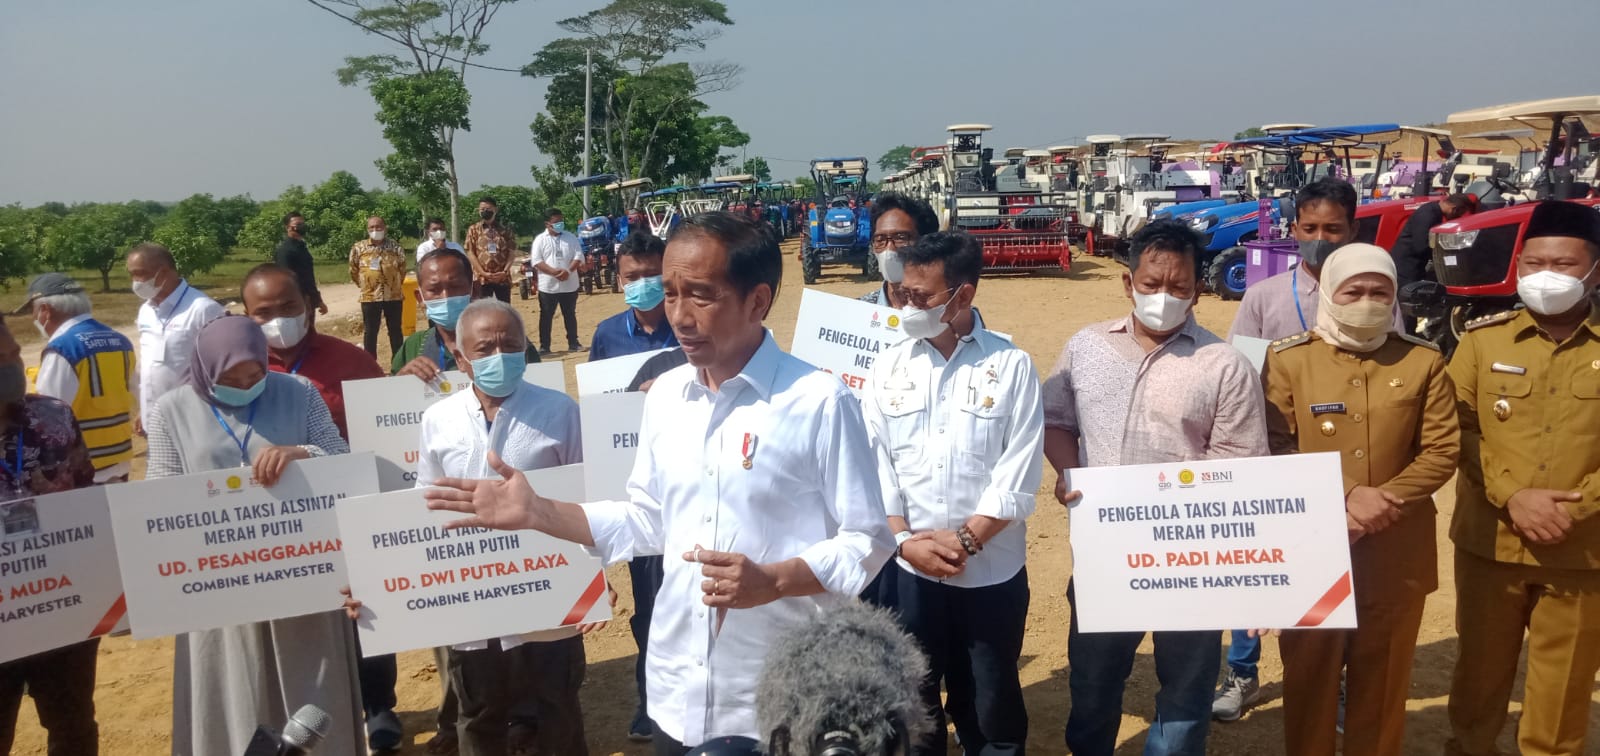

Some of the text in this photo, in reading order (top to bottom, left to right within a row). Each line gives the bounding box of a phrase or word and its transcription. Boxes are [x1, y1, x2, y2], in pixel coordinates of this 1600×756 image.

[818, 327, 880, 354] PENGELOLA
[854, 354, 875, 370] ME
[1212, 470, 1233, 481] BNI
[146, 508, 230, 533] PENGELOLA
[234, 502, 275, 521] TAKSI
[1098, 497, 1306, 523] PENGELOLA TAKSI ALSINTAN
[23, 524, 94, 552] ALSINTAN
[204, 518, 303, 546] MERAH PUTIH
[372, 526, 450, 549] PENGELOLA
[1153, 522, 1256, 541] MERAH PUTIH
[425, 534, 520, 562] MERAH PUTIH
[1127, 548, 1285, 569] UD. PADI MEKAR
[1, 554, 47, 577] PUTIH
[157, 561, 192, 577] UD.
[182, 562, 335, 594] COMBINE HARVESTER
[384, 552, 569, 593] UD. DWI PUTRA RAYA
[10, 573, 72, 601] MUDA
[406, 579, 552, 611] COMBINE HARVESTER
[1129, 574, 1290, 590] COMBINE HARVESTER
